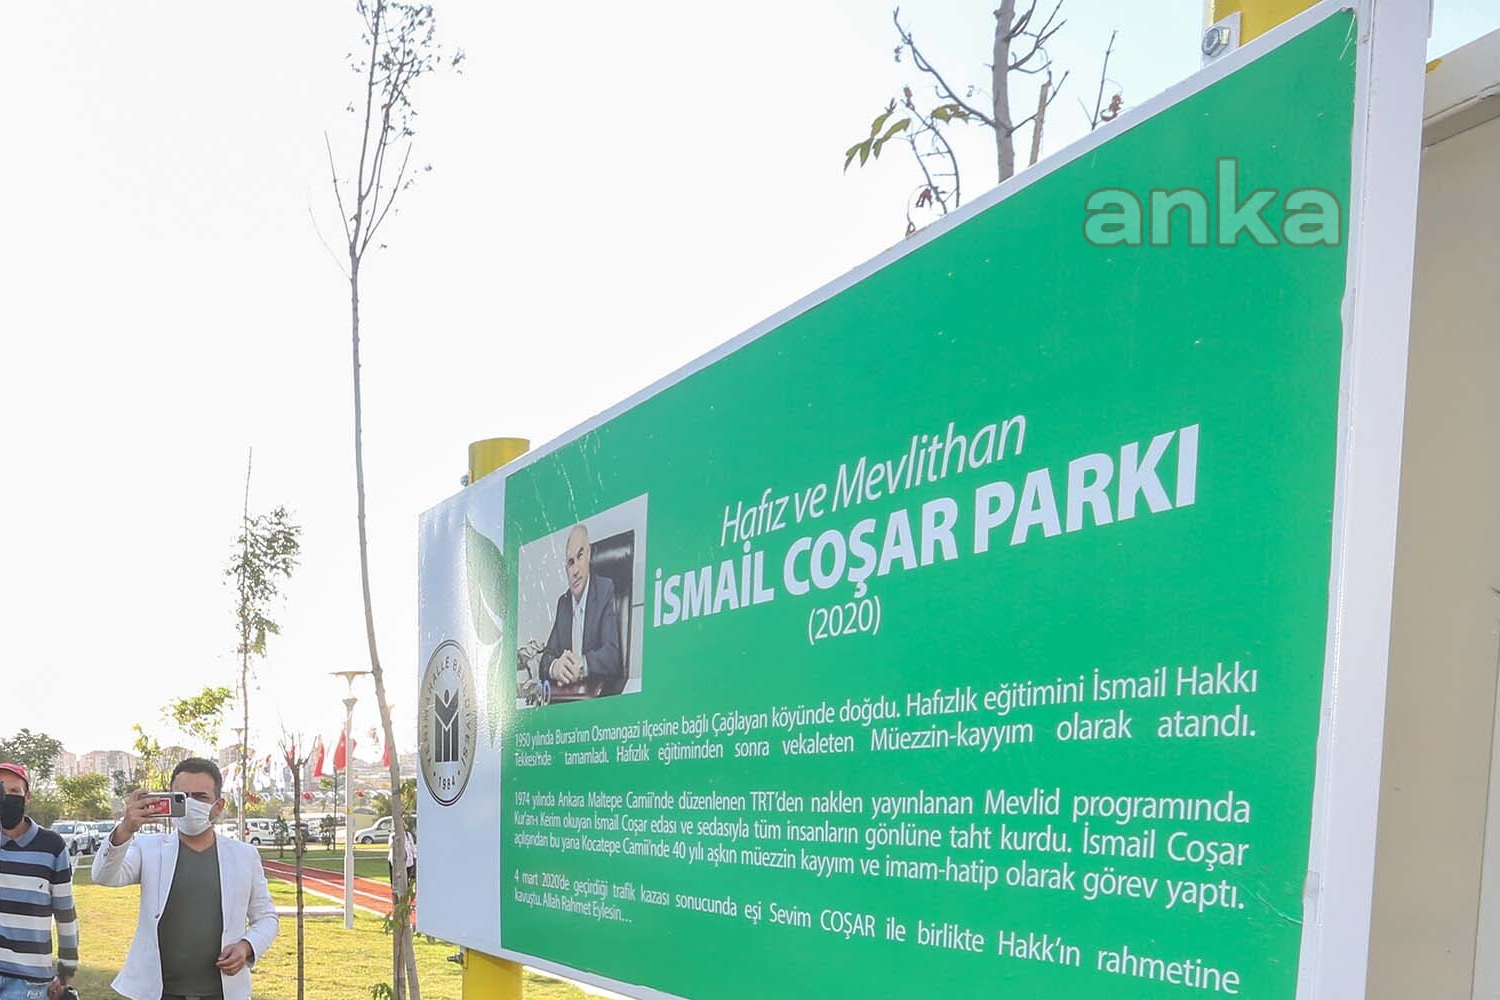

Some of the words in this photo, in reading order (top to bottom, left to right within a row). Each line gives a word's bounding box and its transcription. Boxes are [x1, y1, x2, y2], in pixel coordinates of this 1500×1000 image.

[721, 488, 789, 547] Hafız
[795, 484, 827, 522] ve
[832, 415, 1025, 512] Mevlithan
[653, 541, 774, 627] İSMAİL
[784, 498, 958, 598] COŞAR
[974, 424, 1199, 553] PARKI
[809, 596, 880, 645] (2020)
[616, 743, 650, 763] Hafızlık
[658, 739, 724, 765] eğitiminden
[734, 740, 770, 758] sonra
[781, 731, 855, 756] vekaleten
[870, 720, 1034, 753] Müezzin-kayyım
[1055, 709, 1133, 741] olarak
[1156, 703, 1256, 739] atandı.
[642, 718, 680, 742] ilçesine
[680, 713, 709, 739] bağlı
[710, 709, 768, 737] Çağlayan
[771, 700, 836, 732] köyünde
[838, 694, 901, 727] doğdu.
[905, 685, 978, 717] Hafızlık
[982, 674, 1085, 717] eğitimini
[1091, 665, 1167, 702] İsmail
[1175, 660, 1258, 697] Hakkı
[438, 775, 455, 790] 1984
[625, 791, 675, 810] Camii'nde
[678, 790, 746, 811] düzenlenen
[748, 790, 804, 813] TRT'den
[810, 789, 864, 814] naklen
[870, 788, 974, 821] yayınlanan
[983, 787, 1061, 816] Mevlid
[1071, 789, 1251, 826] programında
[621, 814, 648, 837] Coşar
[650, 815, 677, 835] edası
[680, 820, 694, 835] ve
[696, 816, 750, 843] sedasıyla
[752, 818, 782, 840] tüm
[786, 819, 859, 844] insanların
[864, 821, 943, 851] gönlüne
[948, 821, 993, 850] taht
[999, 823, 1073, 853] kurdu.
[1082, 821, 1156, 859] İsmail
[1166, 830, 1250, 872] Coşar
[622, 837, 671, 858] Camii'nde
[672, 841, 687, 860] 40
[687, 841, 705, 865] yılı
[706, 842, 738, 867] aşkın
[740, 845, 796, 870] müezzin
[800, 847, 855, 879] kayyım
[859, 857, 881, 877] ve
[884, 853, 999, 891] imam-hatip
[1004, 858, 1076, 891] olarak
[1081, 866, 1159, 901] görev
[1164, 879, 1245, 913] yaptı.
[612, 882, 636, 901] trafik
[640, 884, 670, 907] kazası
[675, 894, 738, 917] sonucunda
[743, 900, 762, 925] eşi
[768, 901, 812, 928] Sevim
[819, 908, 876, 940] COŞAR
[885, 915, 907, 942] ile
[916, 919, 985, 953] birlikte
[997, 929, 1081, 967] Hakk'ın
[1096, 944, 1241, 995] rahmetine
